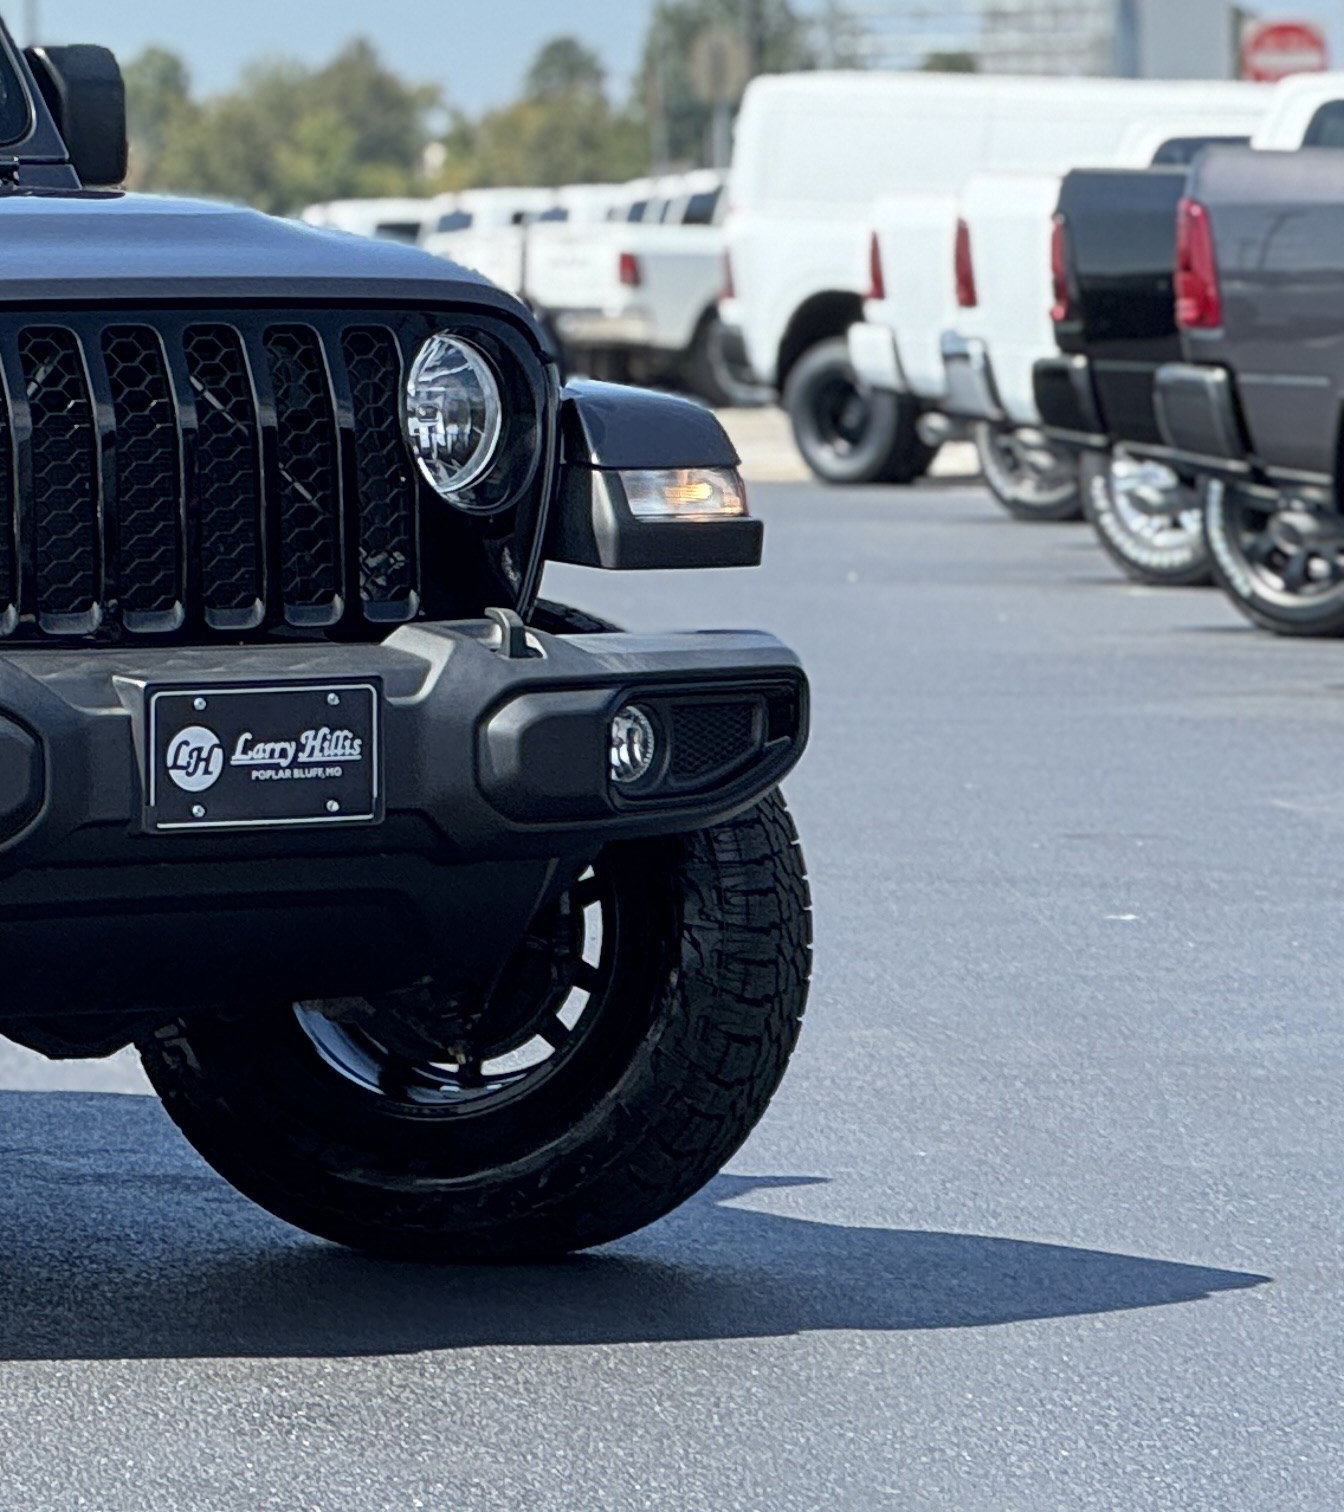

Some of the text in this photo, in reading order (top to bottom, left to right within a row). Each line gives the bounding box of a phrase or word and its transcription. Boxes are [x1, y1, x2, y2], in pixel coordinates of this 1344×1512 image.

[230, 727, 362, 767] Larry Hillis
[251, 769, 292, 780] POPLAR
[325, 766, 343, 777] MO
